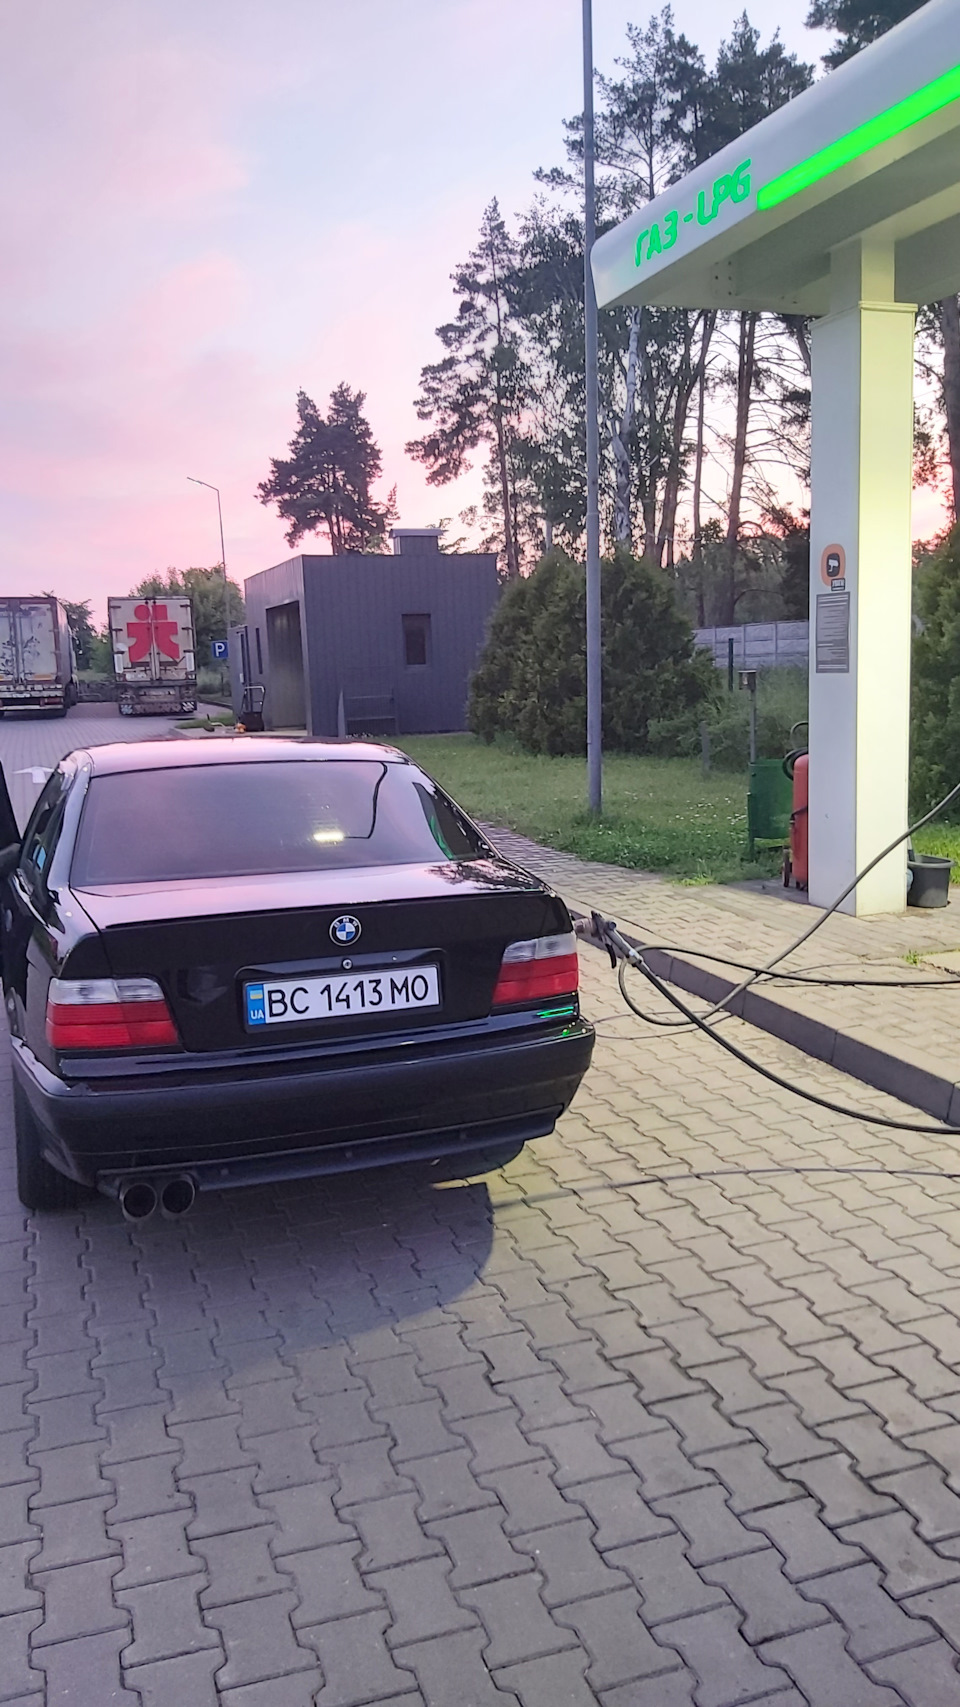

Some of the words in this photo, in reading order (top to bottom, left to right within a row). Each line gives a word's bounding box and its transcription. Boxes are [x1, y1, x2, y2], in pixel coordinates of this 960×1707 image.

[215, 643, 225, 657] P
[267, 986, 310, 1018] BC
[320, 979, 383, 1011] 1413
[390, 975, 429, 1004] MO
[250, 1009, 265, 1020] UA
